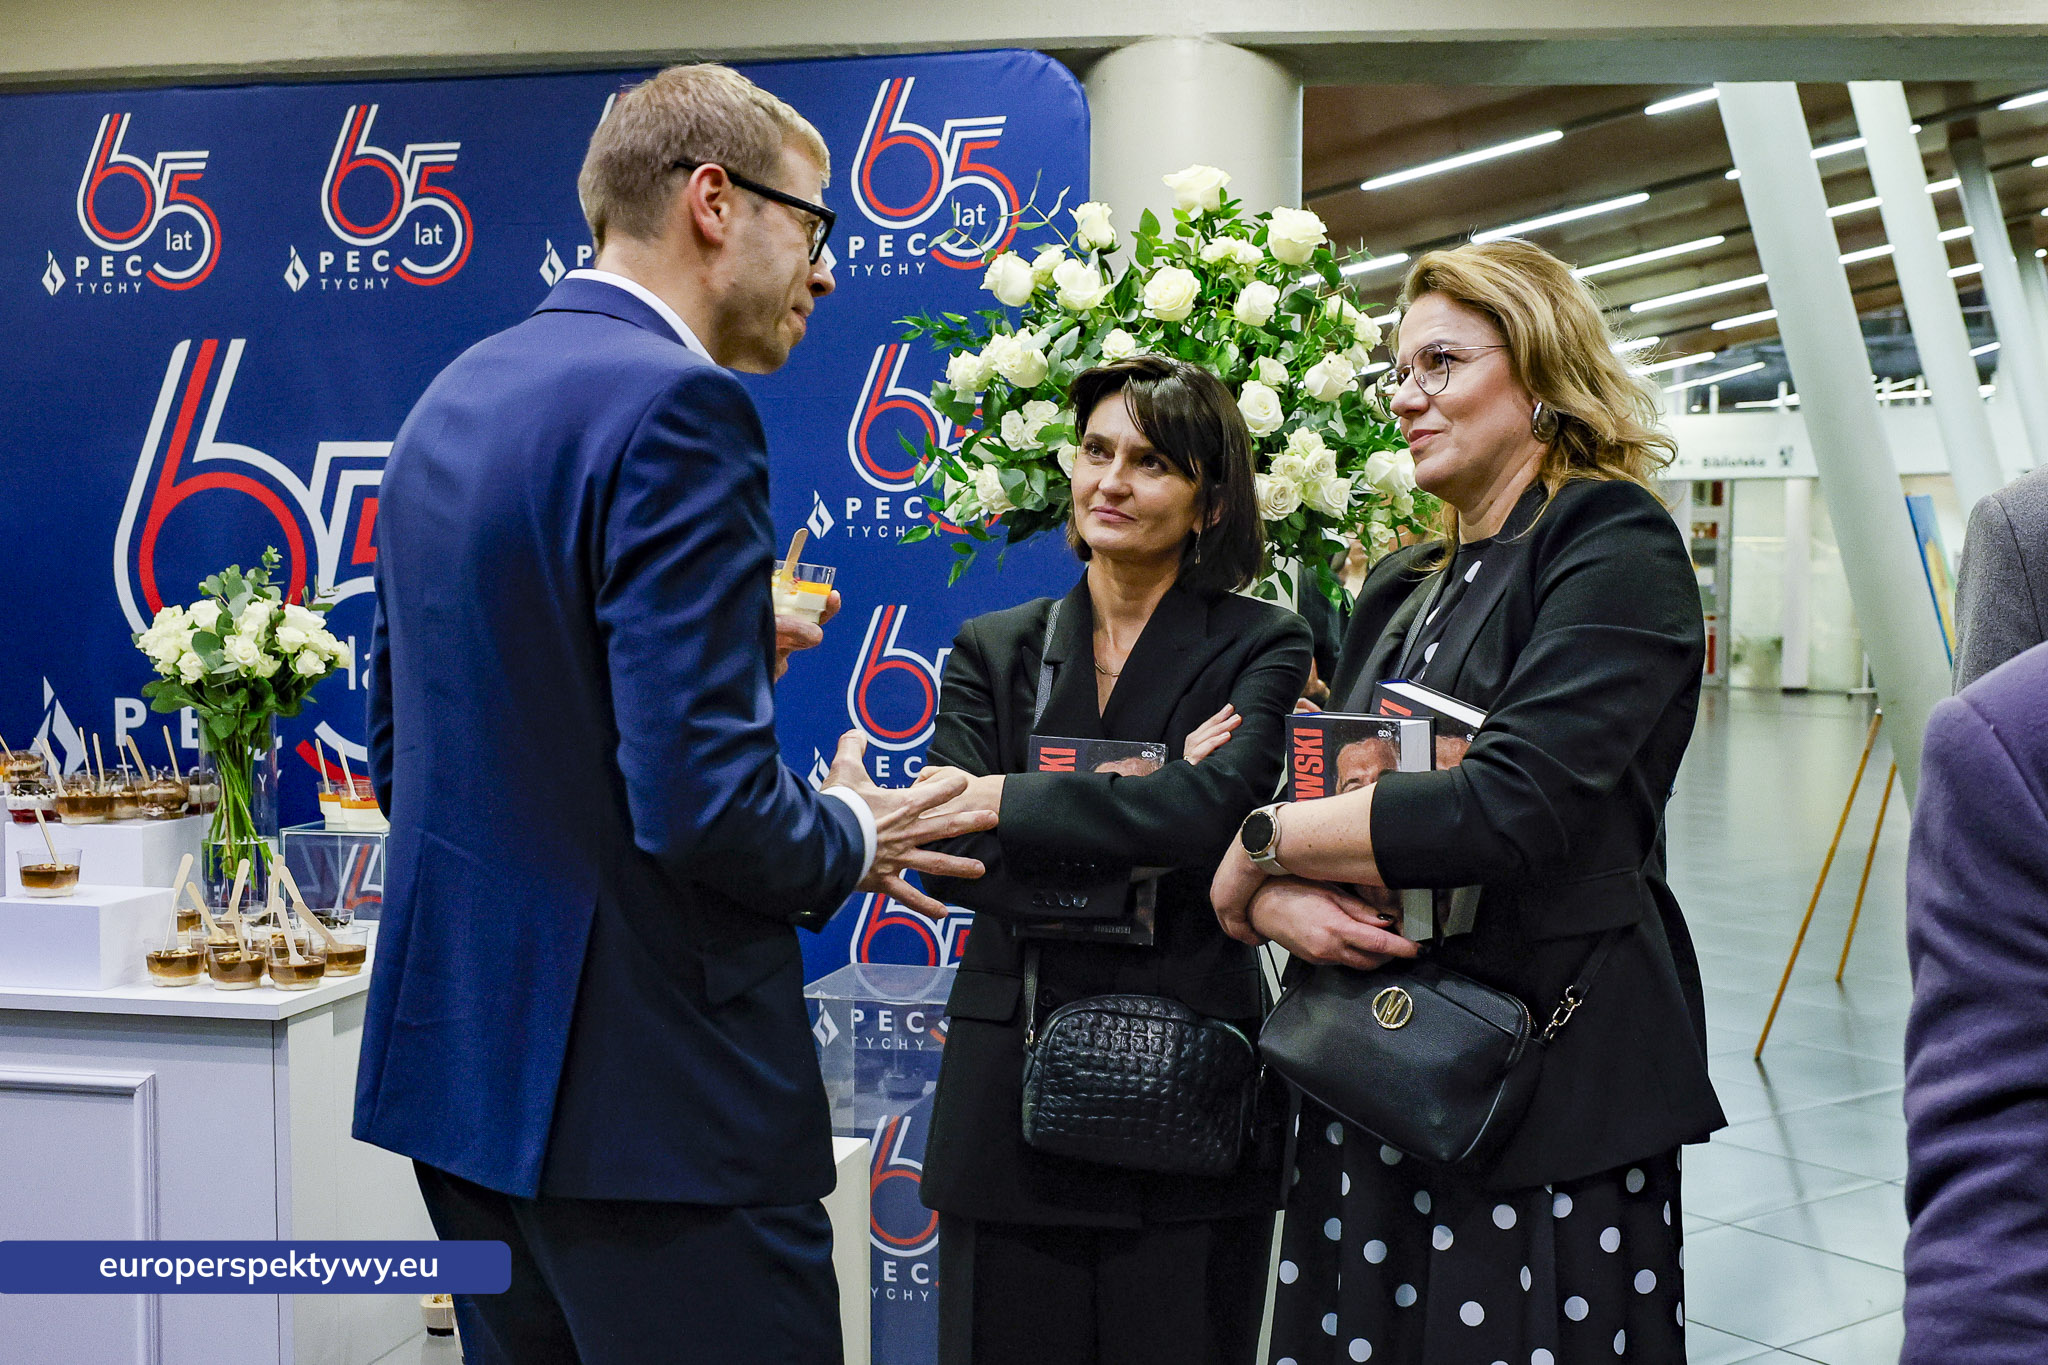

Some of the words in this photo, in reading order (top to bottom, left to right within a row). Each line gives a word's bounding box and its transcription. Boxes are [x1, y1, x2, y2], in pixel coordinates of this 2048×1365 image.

[851, 76, 1020, 270] 65
[77, 113, 221, 290] 65
[321, 104, 474, 286] 65
[954, 202, 986, 227] lat
[166, 228, 192, 252] lat
[414, 223, 443, 246] lat
[848, 233, 926, 259] PEC
[76, 255, 142, 277] PEC
[319, 249, 390, 273] PEC
[849, 262, 925, 277] TYCHY
[76, 282, 142, 294] TYCHY
[321, 277, 390, 289] TYCHY
[846, 496, 923, 520] PEC
[847, 525, 919, 538] TYCH
[875, 756, 922, 778] EC
[1293, 728, 1324, 802] WSKI
[850, 1008, 925, 1033] PEC
[851, 1036, 924, 1051] TYCHY
[884, 1261, 930, 1285] EC
[871, 1287, 929, 1302] YCHY
